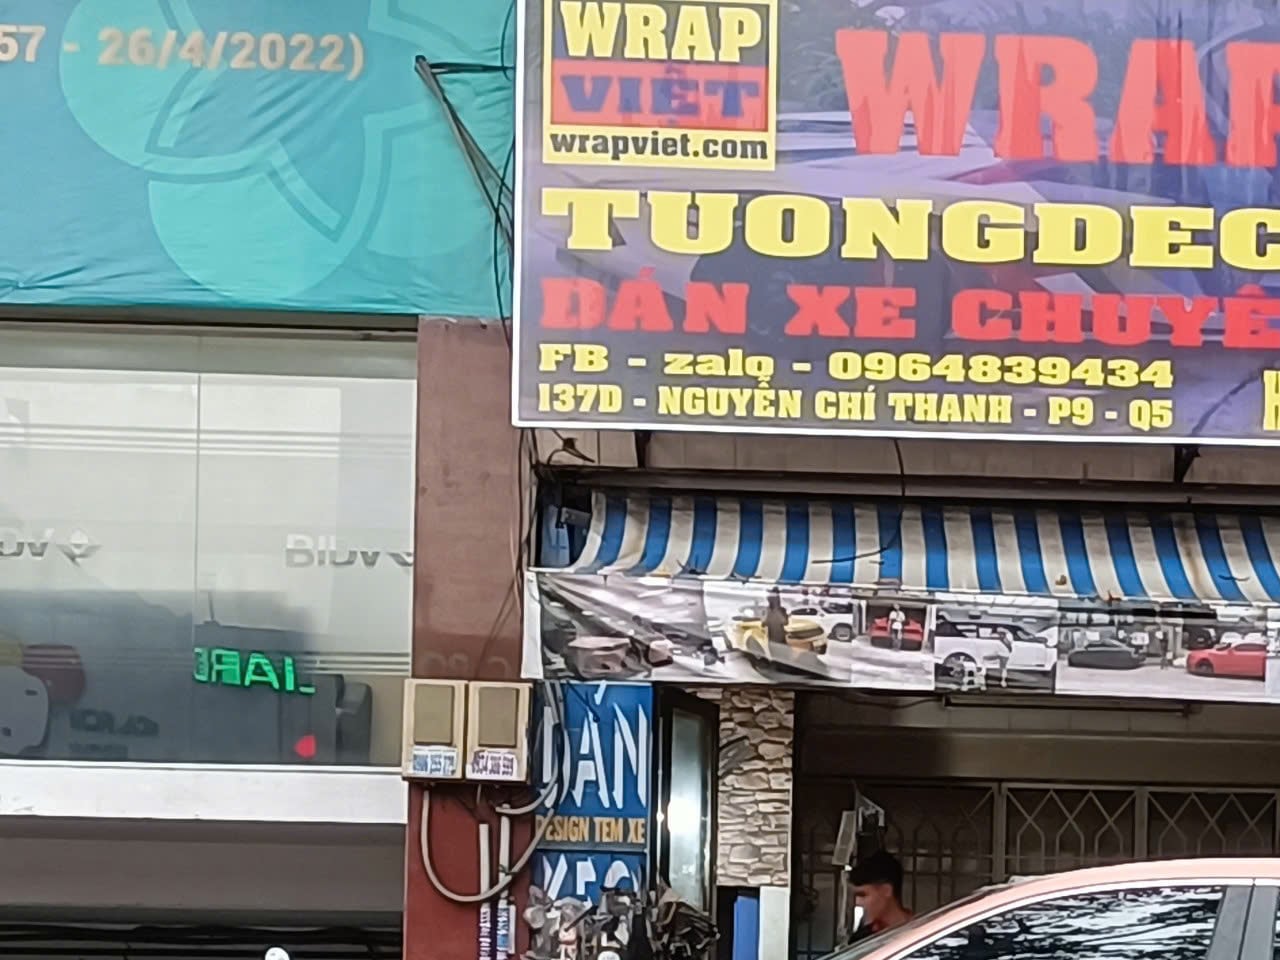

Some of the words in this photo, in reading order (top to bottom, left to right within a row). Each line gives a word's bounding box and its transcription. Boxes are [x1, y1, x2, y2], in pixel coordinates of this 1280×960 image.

[98, 28, 365, 80] 26/4/2022)
[560, 1, 761, 62] WRAP
[560, 63, 760, 127] VIỆT
[549, 131, 768, 160] wrapviet.com
[540, 267, 749, 333] DÁN
[784, 285, 917, 339] XE
[538, 343, 609, 372] FB
[828, 351, 1173, 388] 0964839434
[538, 383, 622, 413] 137D
[657, 375, 803, 418] NGUYỄN
[815, 385, 875, 421] CHÍ
[888, 392, 1012, 423] THANH
[1048, 396, 1094, 425] P9
[1129, 400, 1173, 431] Q5
[594, 816, 624, 843] TEM
[628, 818, 645, 843] XE
